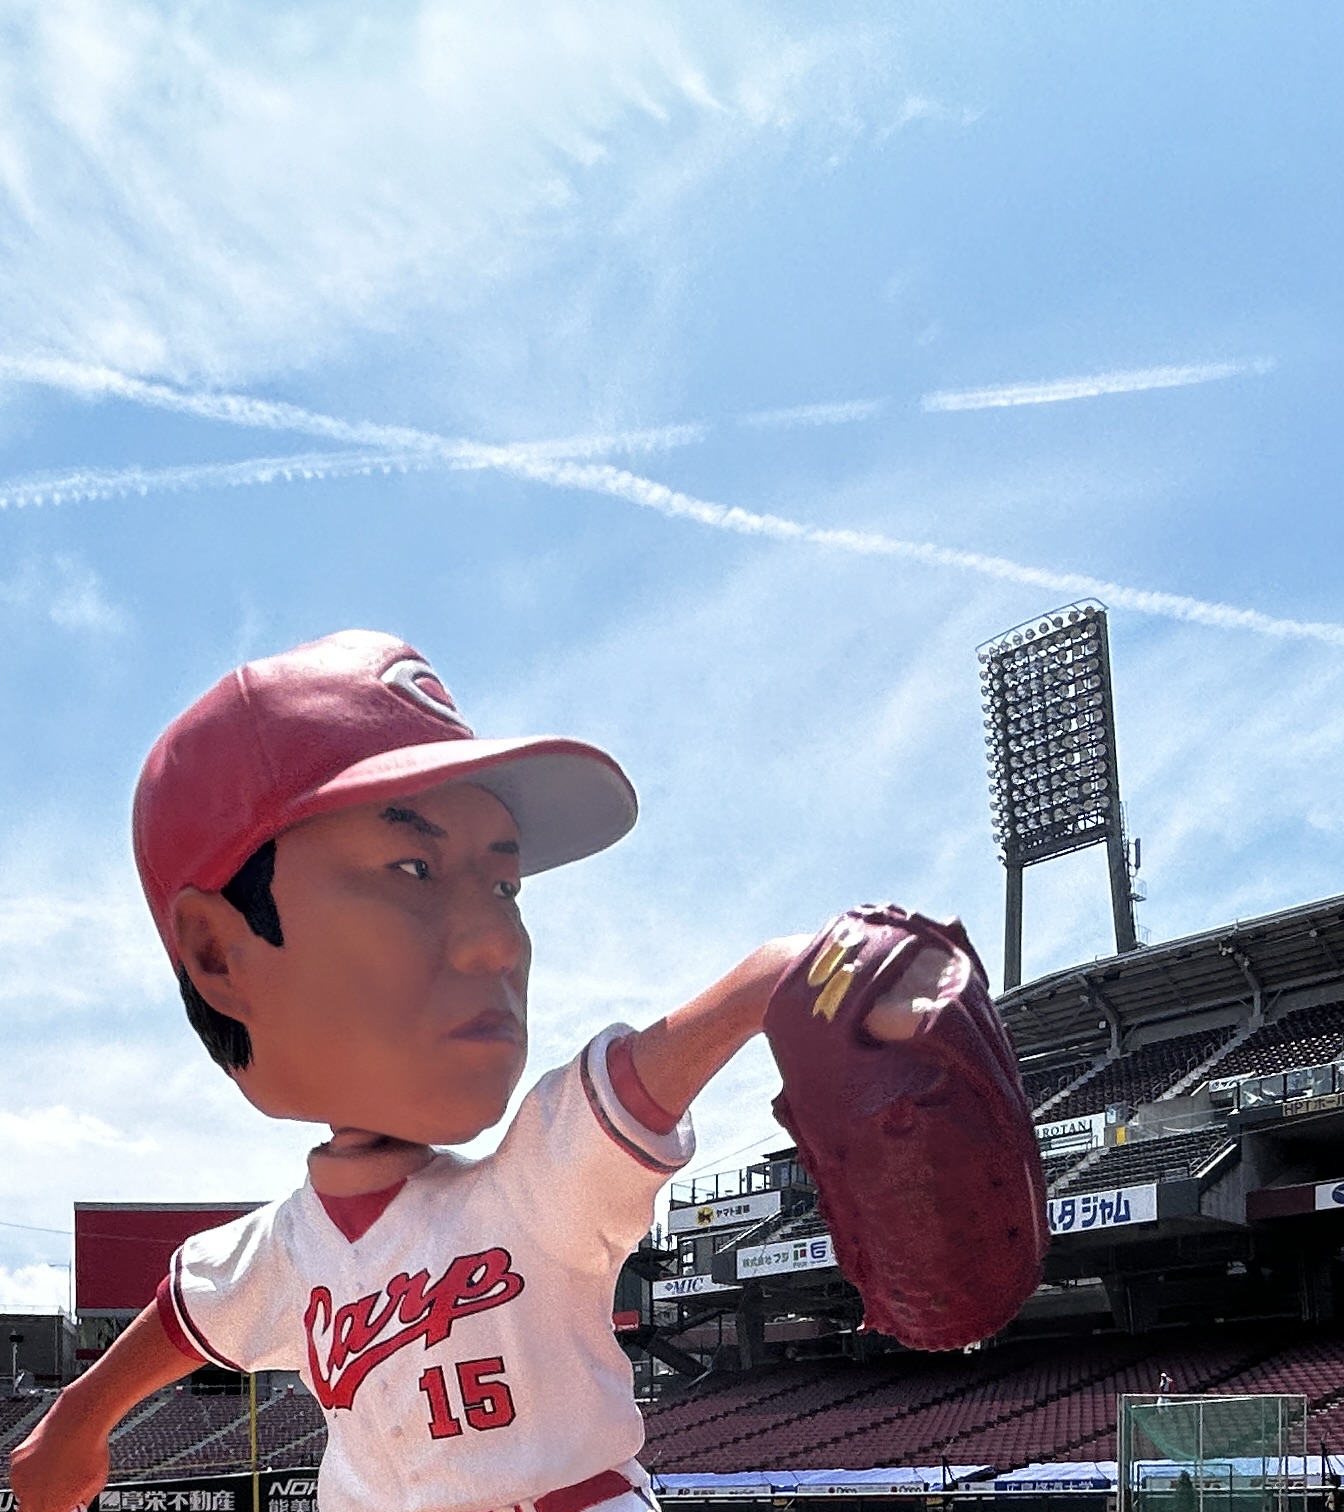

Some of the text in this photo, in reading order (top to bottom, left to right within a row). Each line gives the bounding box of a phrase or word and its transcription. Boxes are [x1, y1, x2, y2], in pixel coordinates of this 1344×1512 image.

[672, 1277, 704, 1296] MIC
[304, 1247, 525, 1411] Carp
[419, 1356, 517, 1440] 15
